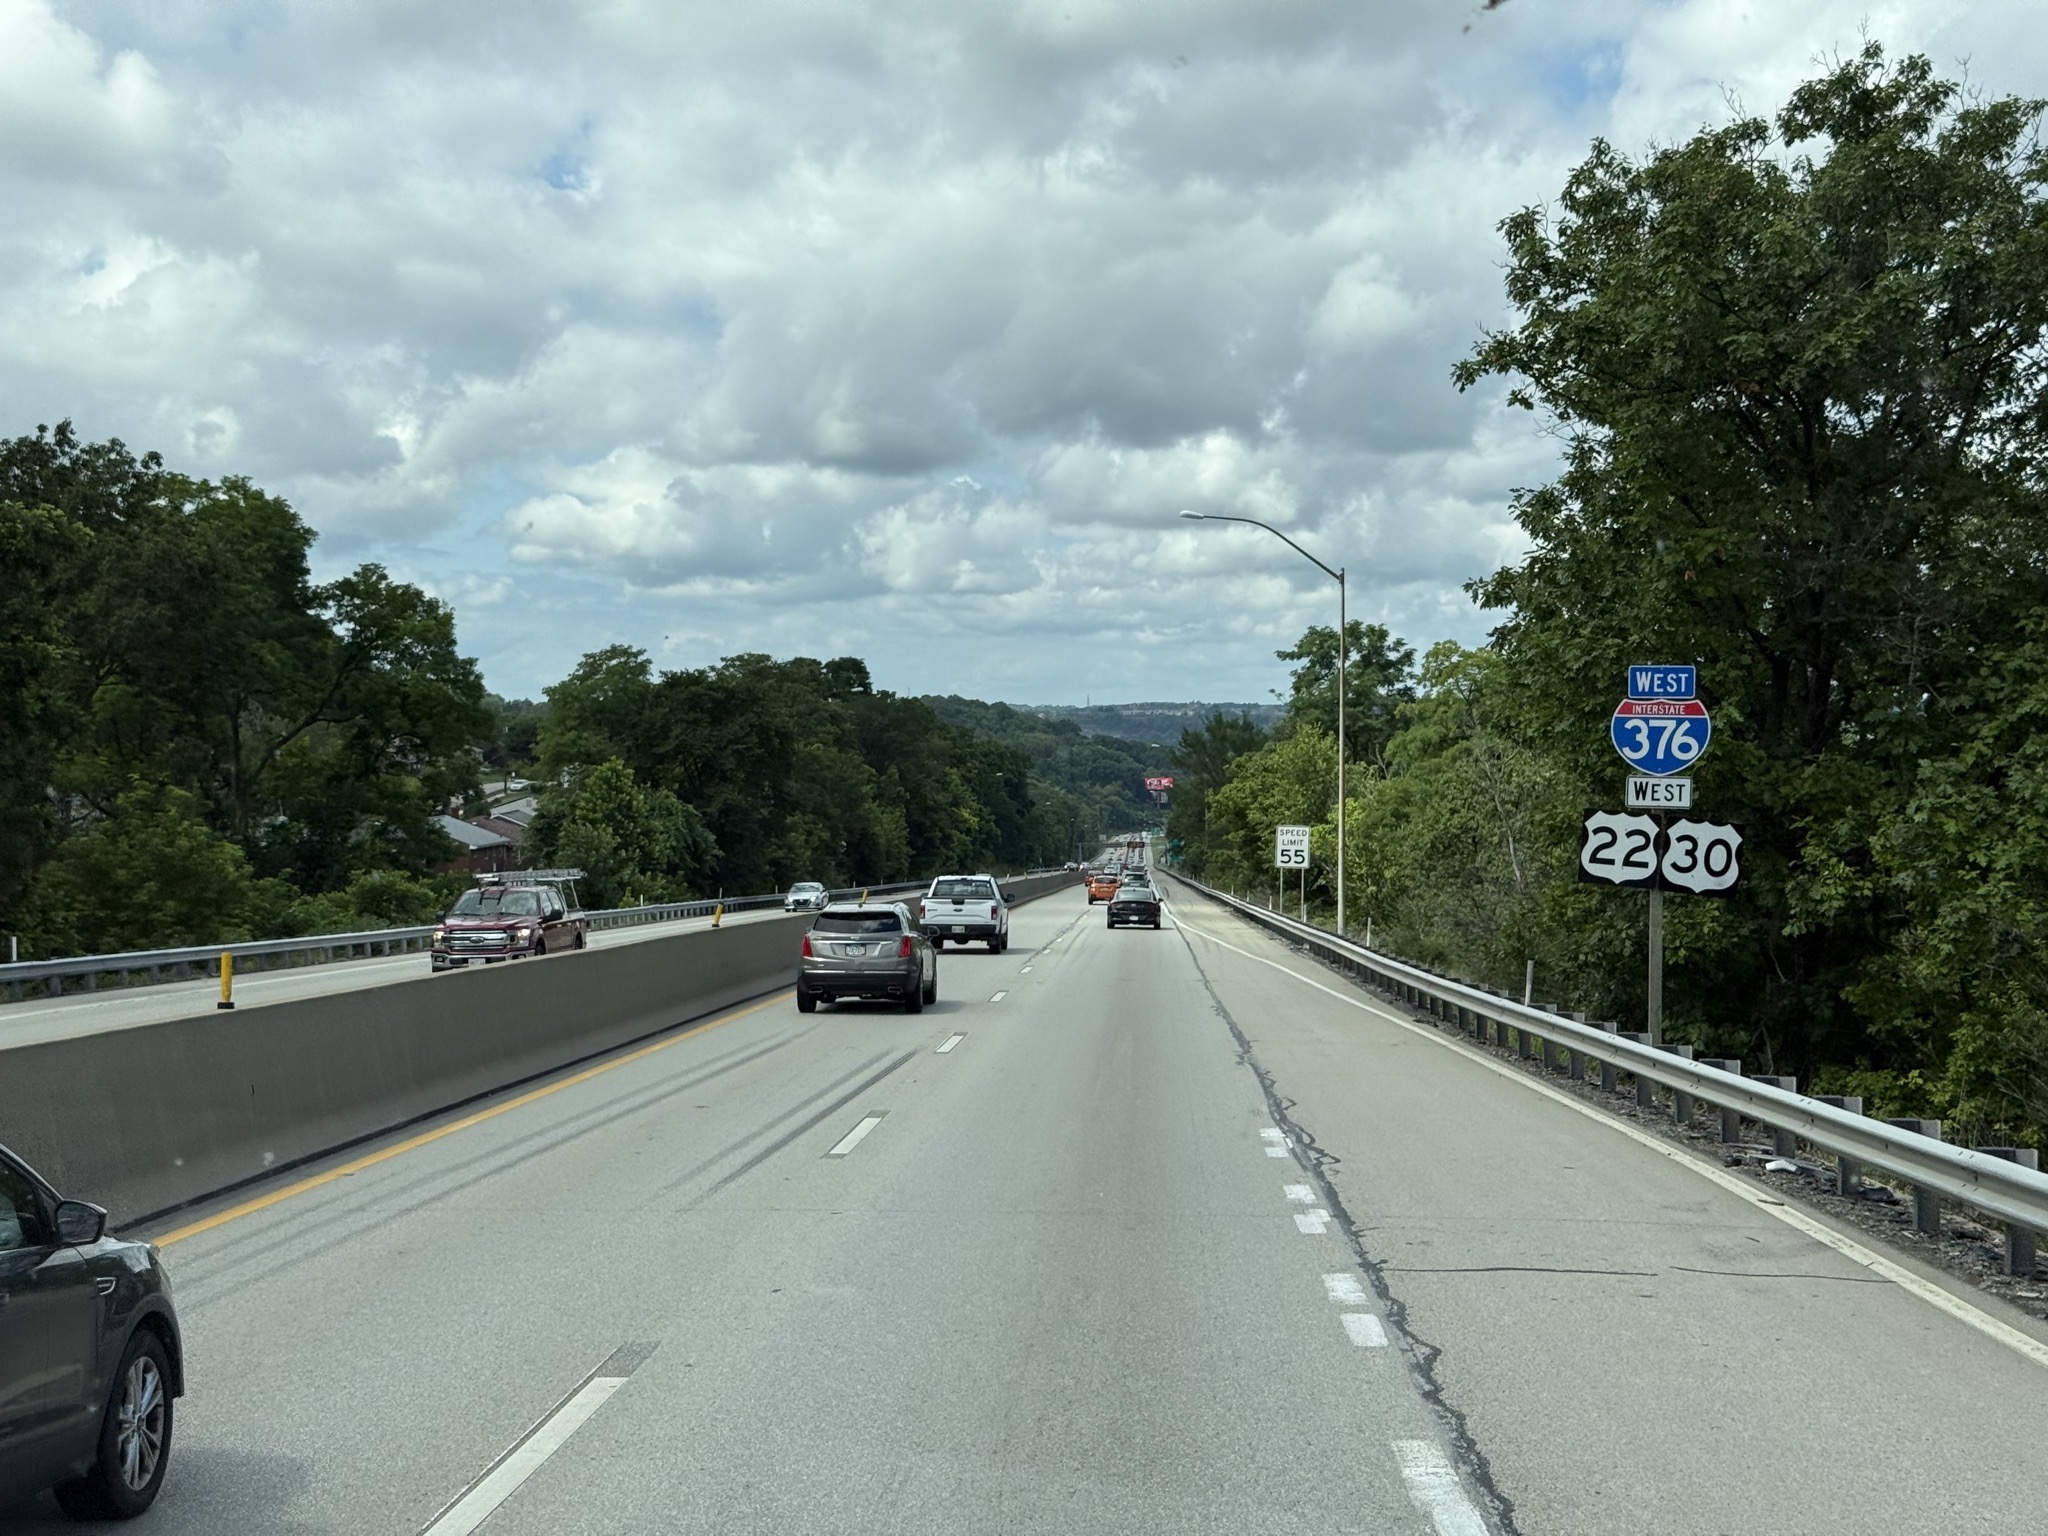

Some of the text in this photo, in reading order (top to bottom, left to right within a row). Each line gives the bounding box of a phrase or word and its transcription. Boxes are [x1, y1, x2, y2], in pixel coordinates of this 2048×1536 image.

[1636, 671, 1688, 693] WEST
[1632, 705, 1685, 715] INTERSTATE
[1622, 719, 1699, 761] 376
[1634, 781, 1686, 802] WEST
[1280, 829, 1308, 837] SPEED
[1280, 849, 1305, 864] 55
[1589, 826, 1651, 869] 22
[1670, 834, 1732, 878] 30
